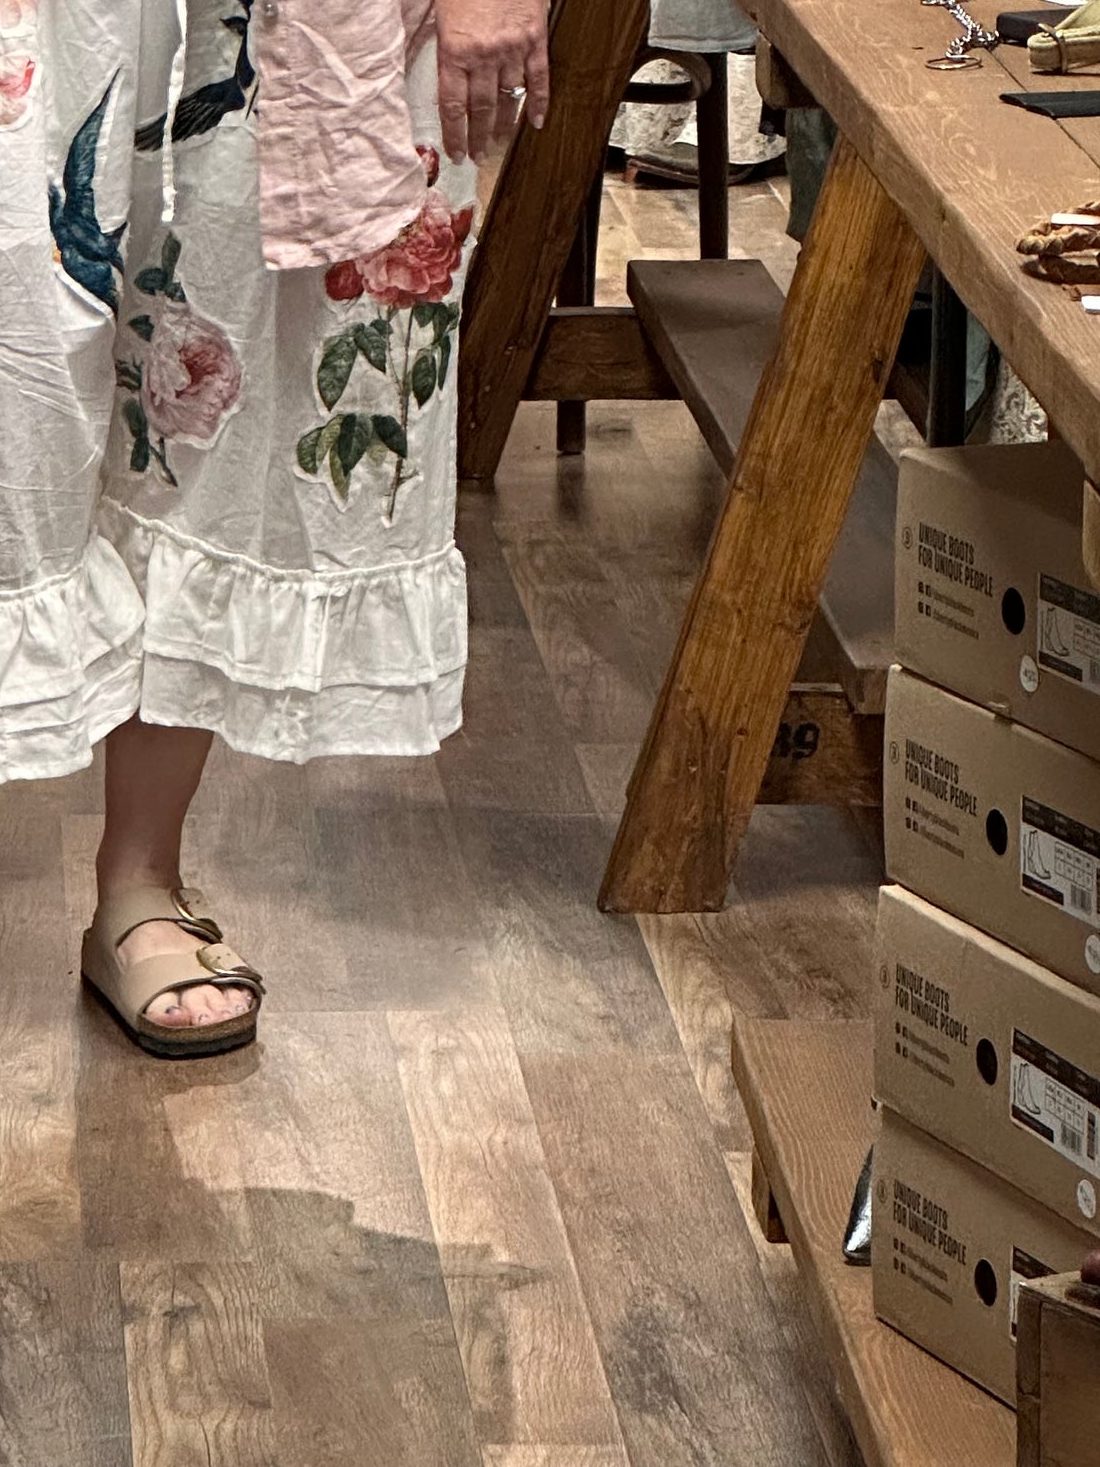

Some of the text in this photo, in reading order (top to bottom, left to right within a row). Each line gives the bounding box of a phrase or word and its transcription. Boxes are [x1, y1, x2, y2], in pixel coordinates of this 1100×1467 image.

[919, 522, 974, 565] UNIQUE BOOTS
[918, 545, 993, 598] FOR UNIQUE PEOPLE
[905, 738, 959, 785] UNIQUE BOOTS
[905, 760, 919, 785] FOR
[920, 766, 948, 802] UNIQUE
[950, 785, 977, 817] PEOPLE
[896, 963, 949, 1013] UNIQUE BOOTS
[895, 985, 968, 1046] FOR UNIQUE PEOPLE
[922, 1197, 948, 1231] BOOTS
[938, 1230, 966, 1266] PEOPLE
